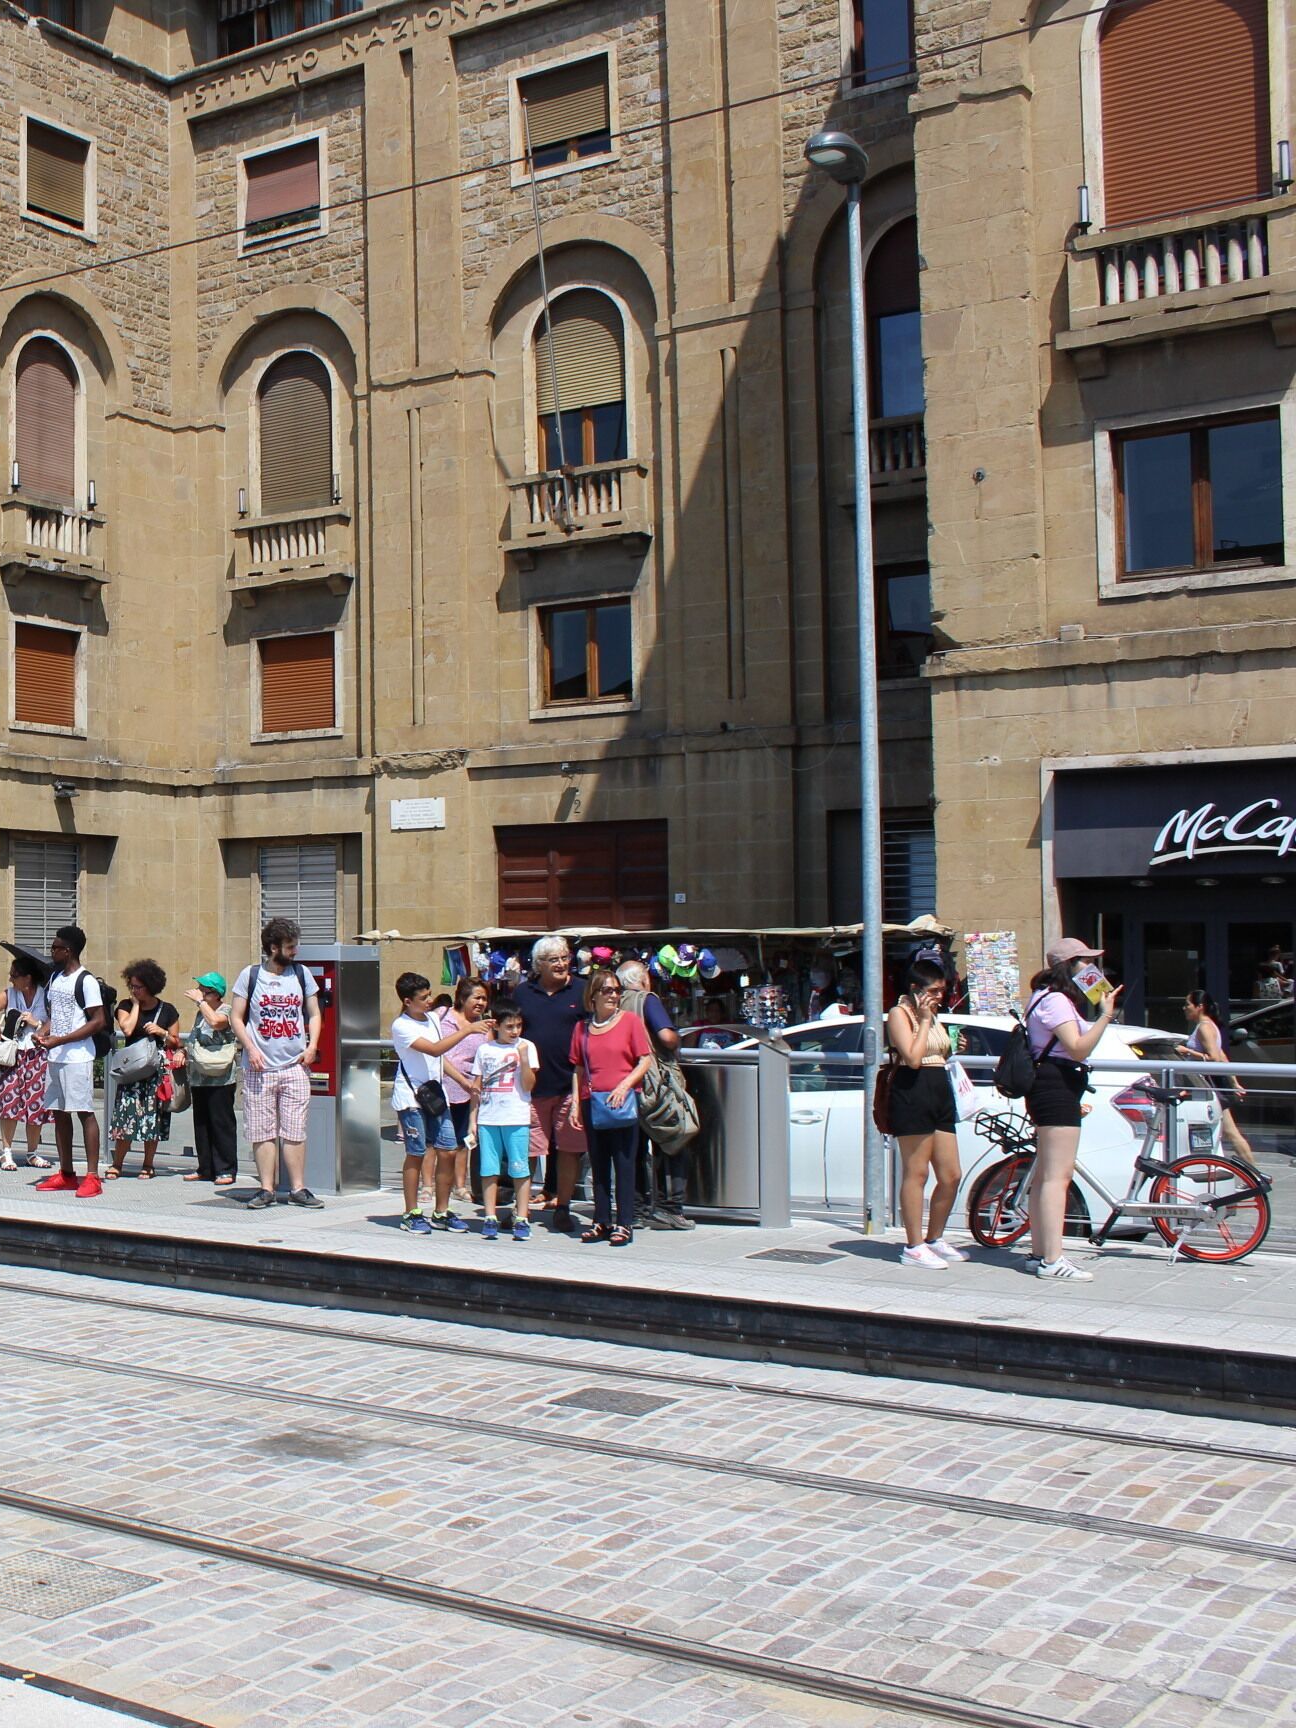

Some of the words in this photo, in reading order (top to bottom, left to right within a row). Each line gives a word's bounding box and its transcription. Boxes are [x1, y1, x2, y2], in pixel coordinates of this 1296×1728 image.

[182, 48, 319, 113] ISTITVTO
[573, 799, 581, 814] 2
[1153, 798, 1296, 860] McCa
